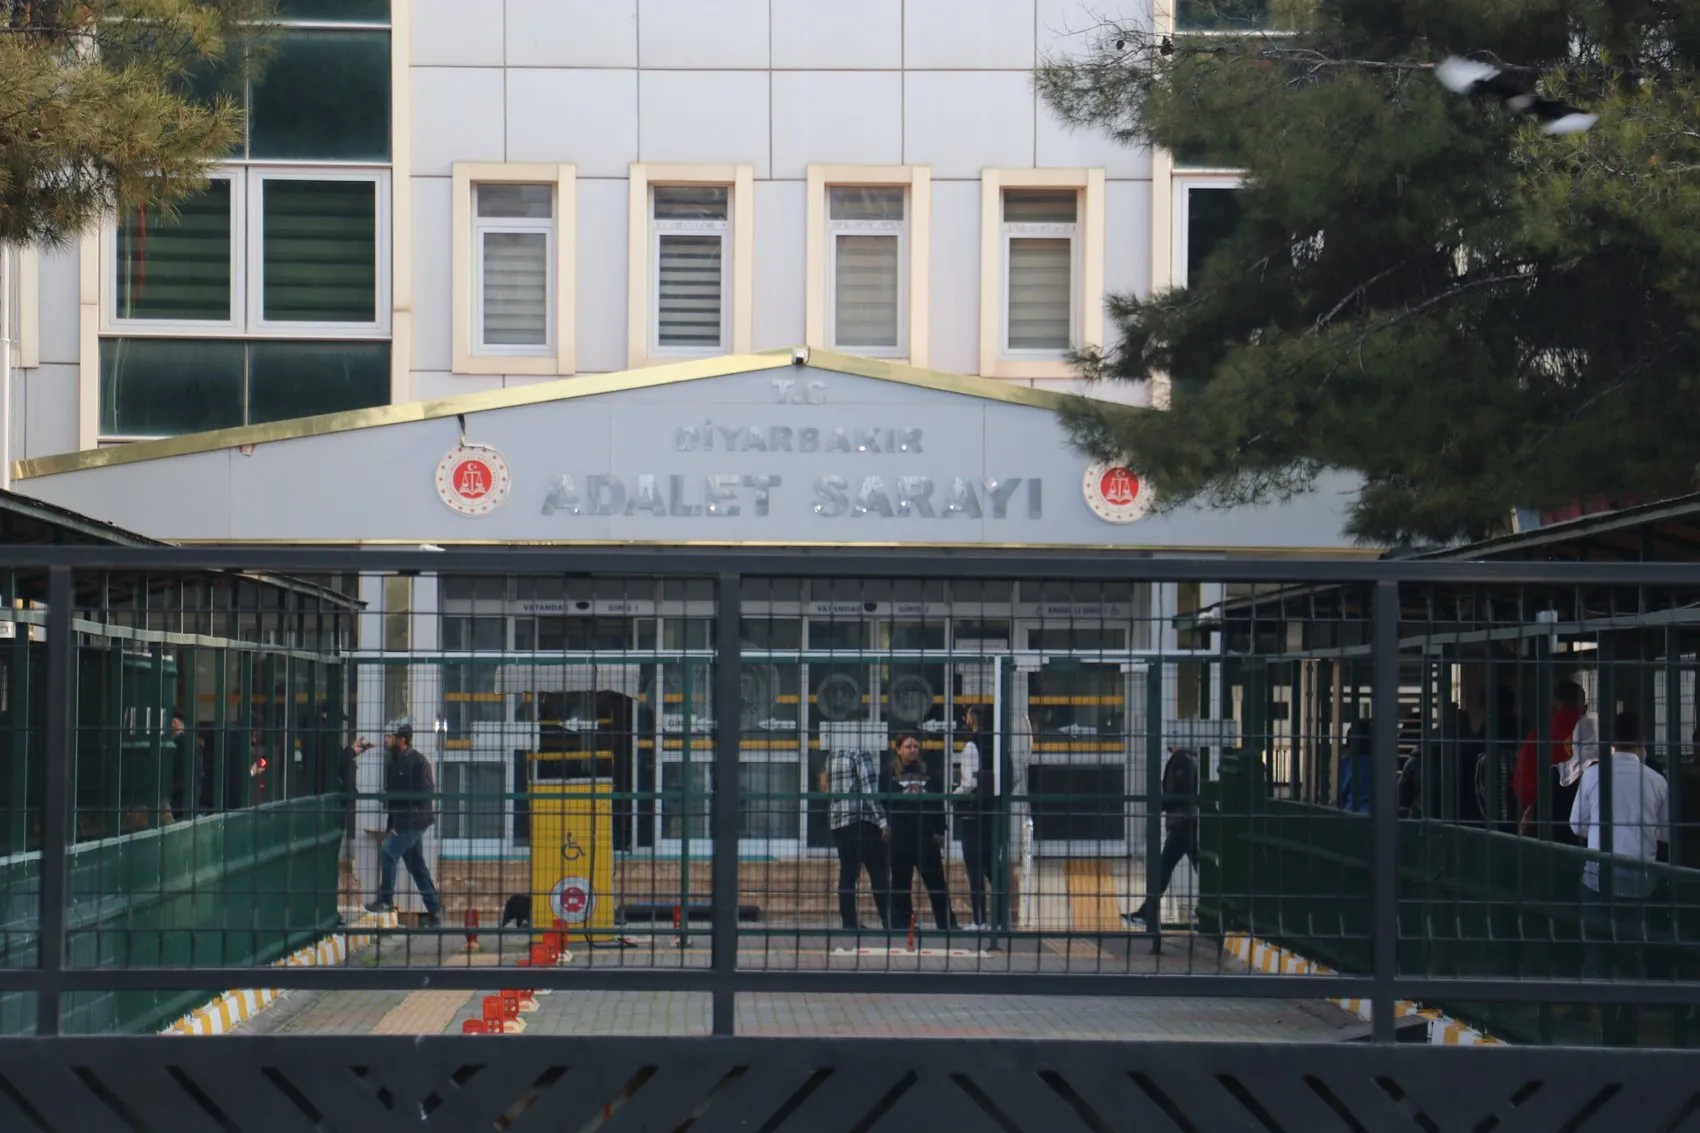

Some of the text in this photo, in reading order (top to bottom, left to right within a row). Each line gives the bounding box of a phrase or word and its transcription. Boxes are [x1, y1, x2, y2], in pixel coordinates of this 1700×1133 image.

[674, 418, 924, 453] DİYARBAKIR
[541, 473, 782, 517] ADALET
[812, 474, 1042, 520] SARAYI
